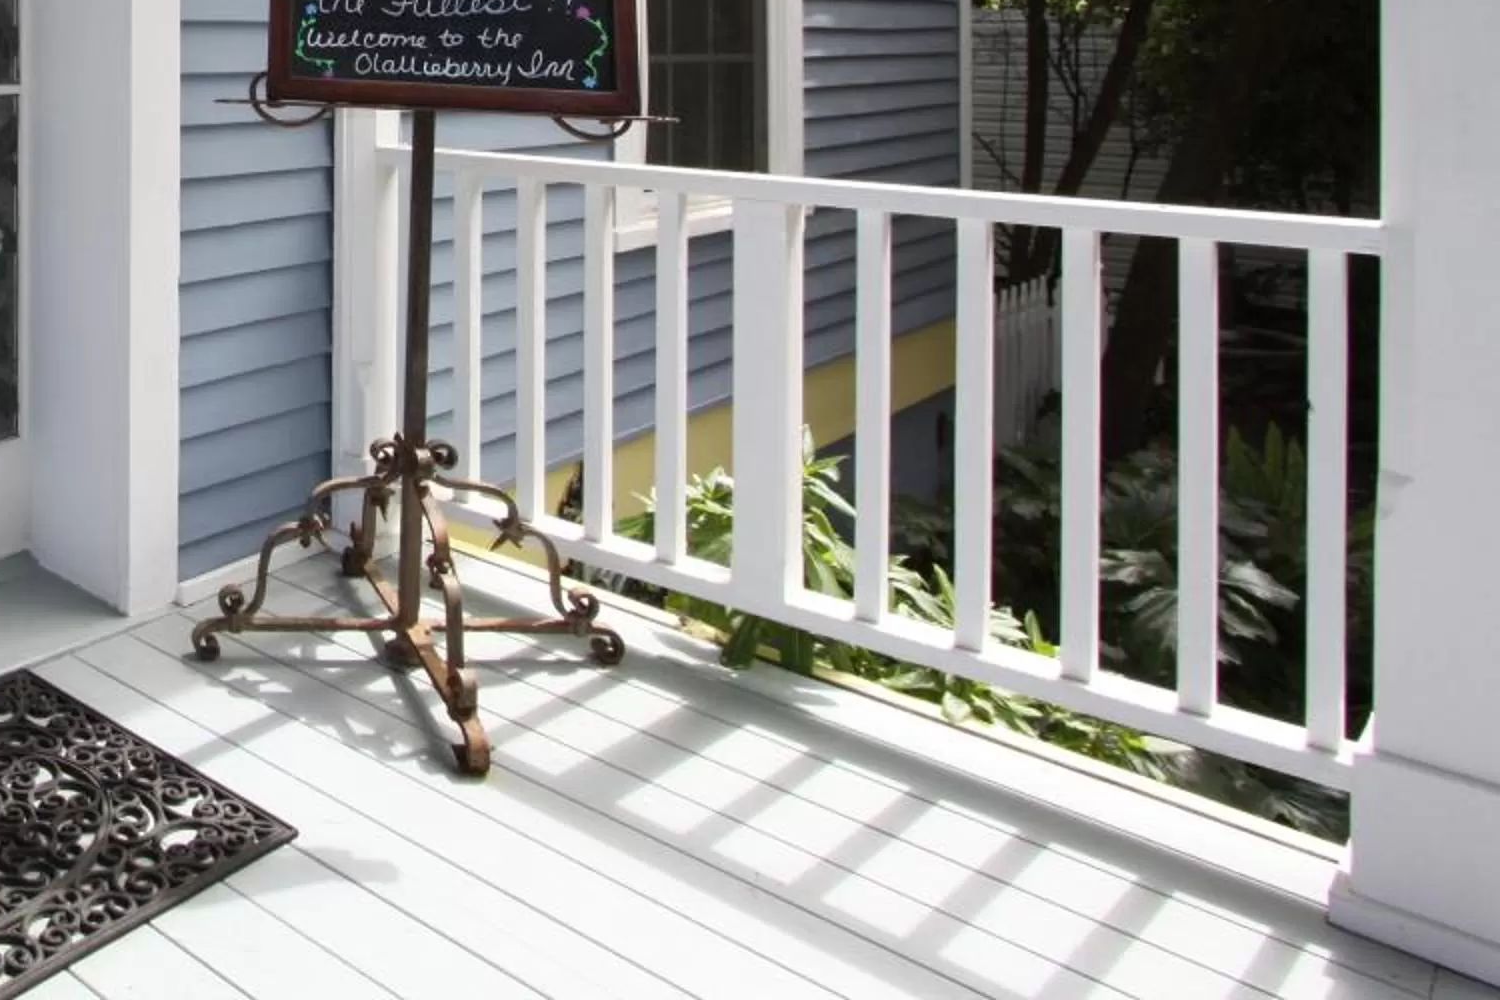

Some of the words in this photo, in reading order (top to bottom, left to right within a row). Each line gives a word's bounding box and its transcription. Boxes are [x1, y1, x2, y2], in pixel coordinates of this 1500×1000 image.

[438, 29, 464, 48] to
[477, 28, 523, 49] the
[355, 53, 513, 85] Olallieberry
[517, 50, 575, 80] Inn
